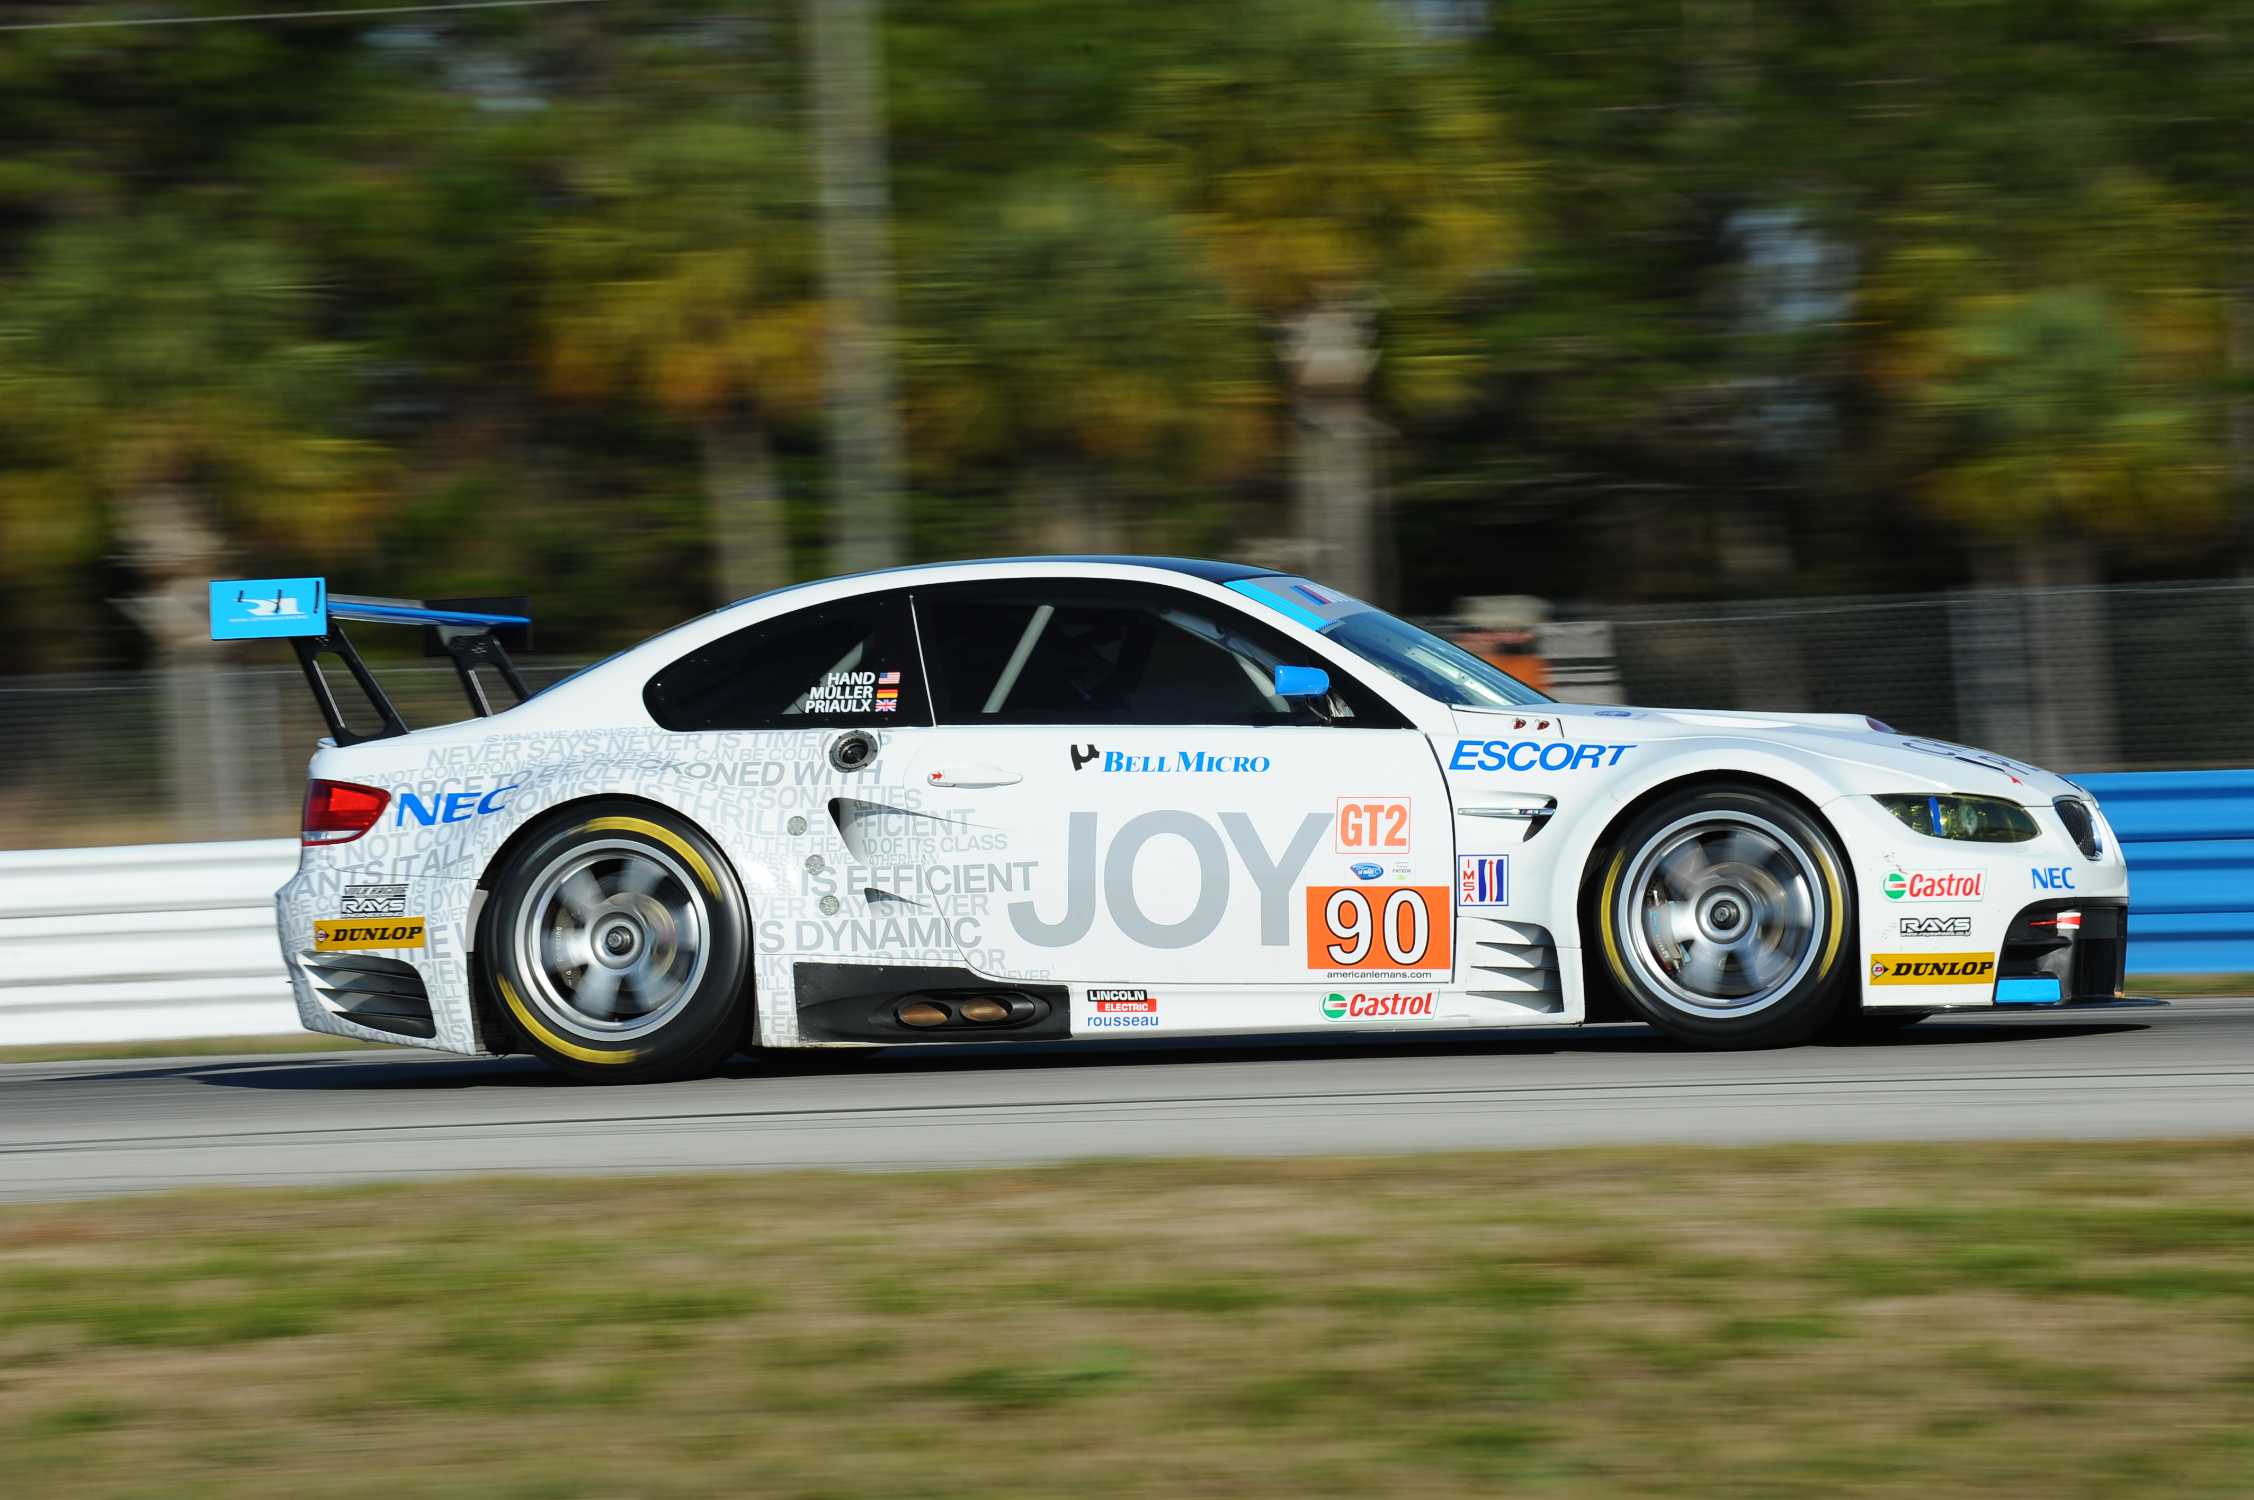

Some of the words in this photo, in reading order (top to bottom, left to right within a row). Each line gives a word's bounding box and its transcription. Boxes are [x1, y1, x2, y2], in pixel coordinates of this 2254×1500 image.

[828, 672, 875, 685] HAND
[810, 684, 873, 699] MÜLLER
[805, 699, 872, 713] PRIAULX
[427, 741, 522, 769] NEVER
[527, 735, 601, 760] SAYS
[606, 732, 704, 752] NEVER
[716, 733, 741, 750] IS
[694, 749, 735, 762] CAN
[739, 748, 766, 762] BE
[1448, 740, 1638, 772] ESCORT
[588, 758, 786, 787] RECKONED
[396, 785, 519, 827] NEC
[1340, 803, 1408, 848] GT2
[881, 837, 903, 854] OF
[906, 836, 936, 854] ITS
[940, 832, 1009, 853] CLASS
[421, 834, 473, 877] ALL
[846, 861, 1040, 897] EFFICIENT
[1007, 809, 1335, 950] JOY
[1908, 872, 1981, 898] Castrol
[2031, 866, 2076, 889] NEC
[341, 899, 406, 914] RAYS
[901, 893, 990, 917] NEVER
[332, 926, 424, 942] DUNLOP
[795, 915, 983, 952] DYNAMIC
[1324, 887, 1432, 966] 90
[1900, 917, 1971, 934] RAYS
[1326, 970, 1433, 980] americanlemans.com
[1891, 961, 1994, 977] DUNLOP
[1089, 990, 1145, 1001] LINCOLN
[1349, 992, 1433, 1018] Castrol
[1104, 1003, 1149, 1012] ELECTRIC
[1087, 1014, 1159, 1027] rousseau
